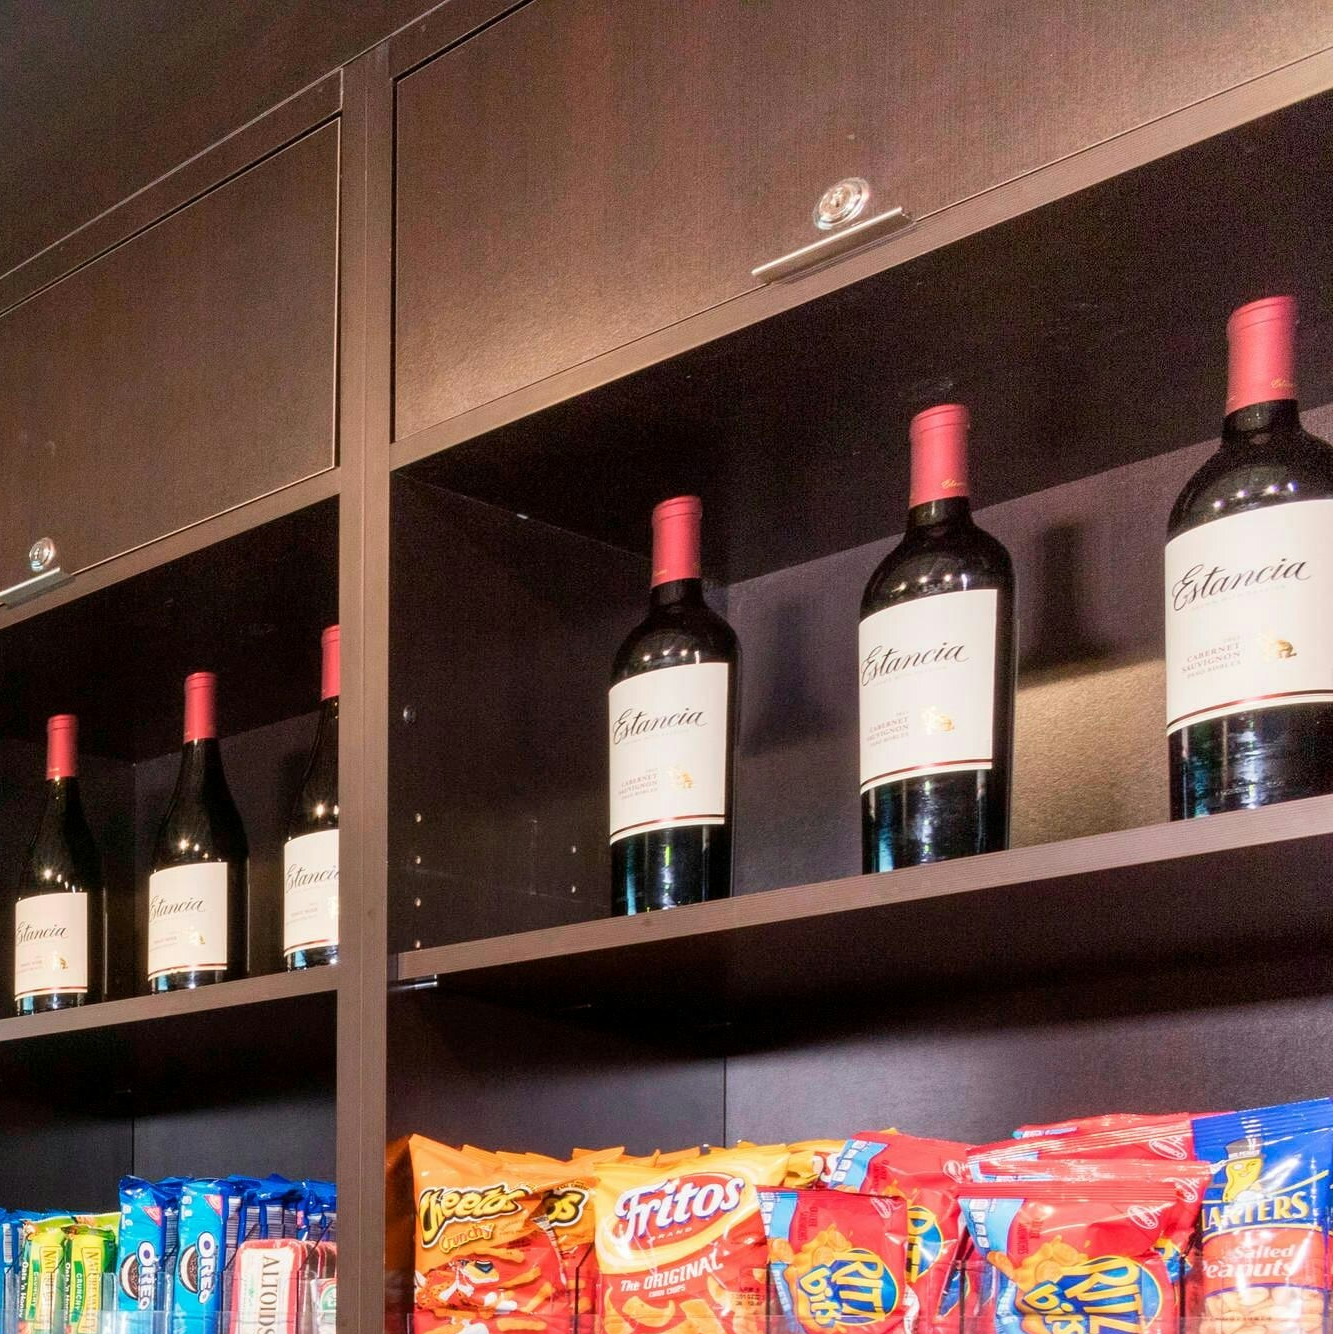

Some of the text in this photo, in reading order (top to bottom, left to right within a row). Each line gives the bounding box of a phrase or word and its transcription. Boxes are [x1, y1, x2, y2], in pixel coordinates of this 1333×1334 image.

[1172, 558, 1311, 611] Estancia
[861, 642, 969, 687] Estancia
[1186, 643, 1240, 662] CABERNET
[613, 708, 707, 745] Estancia
[149, 896, 205, 923] Estancia
[15, 922, 69, 946] Estancia
[418, 1184, 528, 1247] Cheetos
[614, 1174, 746, 1242] Fritos
[1201, 1191, 1310, 1232] LANTERS
[439, 1219, 496, 1254] Crunchy
[1233, 1243, 1295, 1259] Salted
[137, 1241, 155, 1310] OREO
[197, 1231, 216, 1304] OREO
[620, 1247, 724, 1292] The ORIGINAL
[831, 1252, 885, 1326] RITZ
[1201, 1257, 1293, 1280] eanuts
[74, 1272, 82, 1310] CRUNCHY
[798, 1267, 842, 1327] bits
